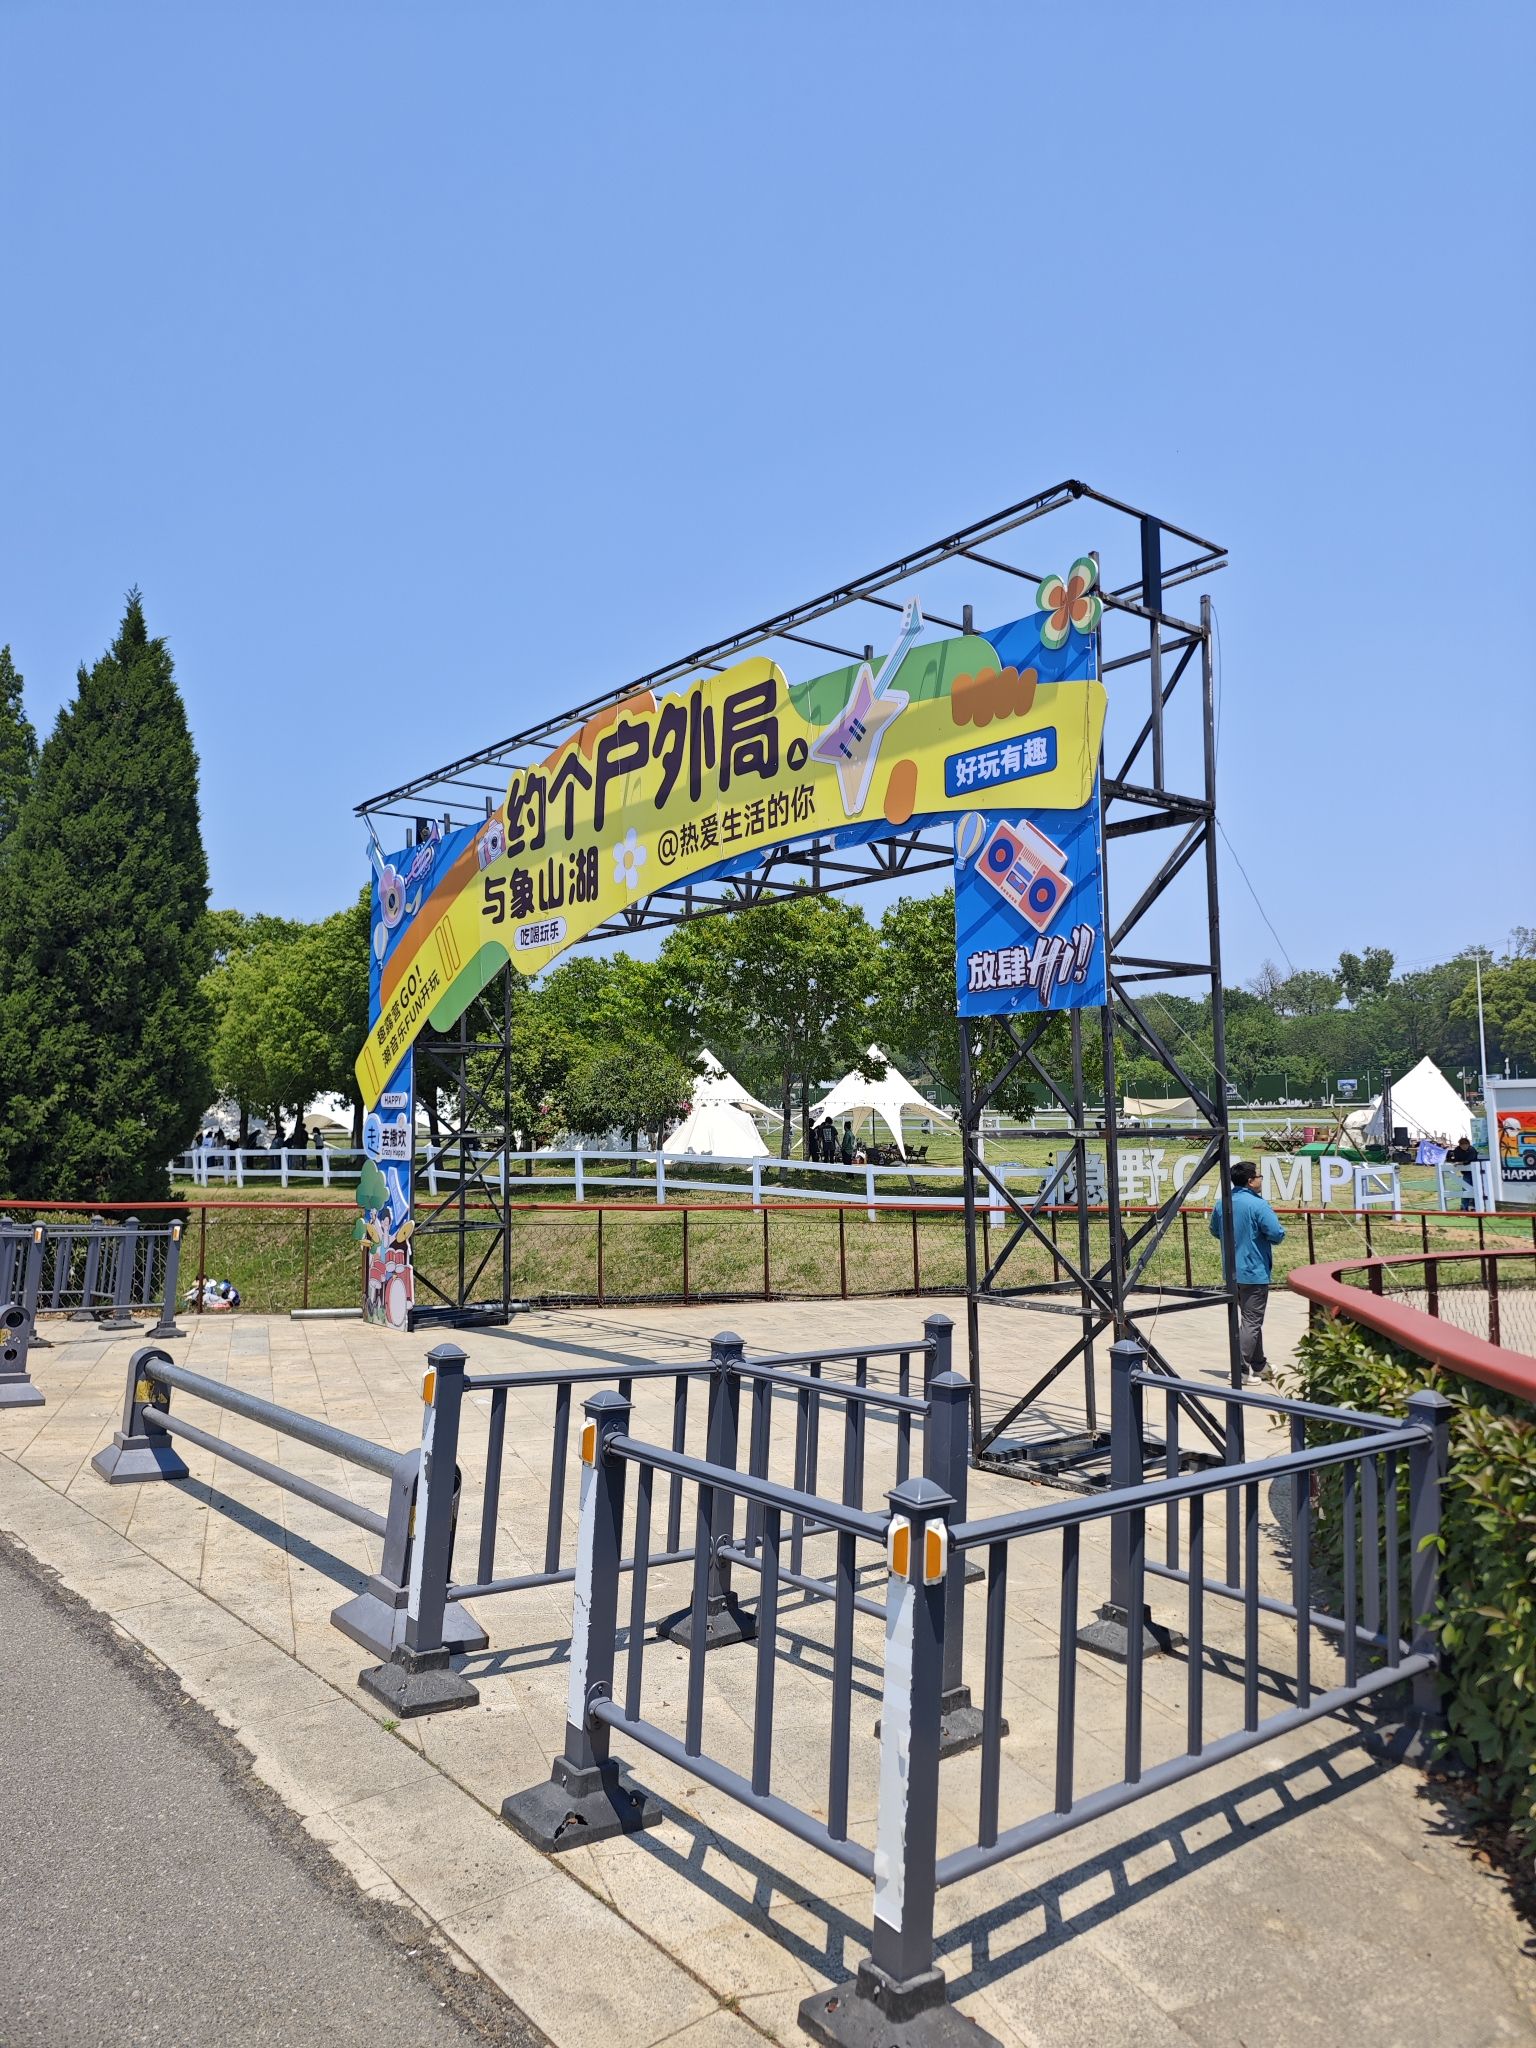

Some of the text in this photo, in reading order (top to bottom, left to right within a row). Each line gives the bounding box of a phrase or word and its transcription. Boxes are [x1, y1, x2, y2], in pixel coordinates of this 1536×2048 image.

[955, 736, 1048, 788] 好玩有趣
[657, 783, 816, 867] @热爱生活的你
[481, 845, 599, 925] 与象山湖
[520, 920, 560, 946] 吃喝玩乐
[384, 1094, 402, 1105] HAPPY
[381, 1147, 406, 1159] Crazy Happy
